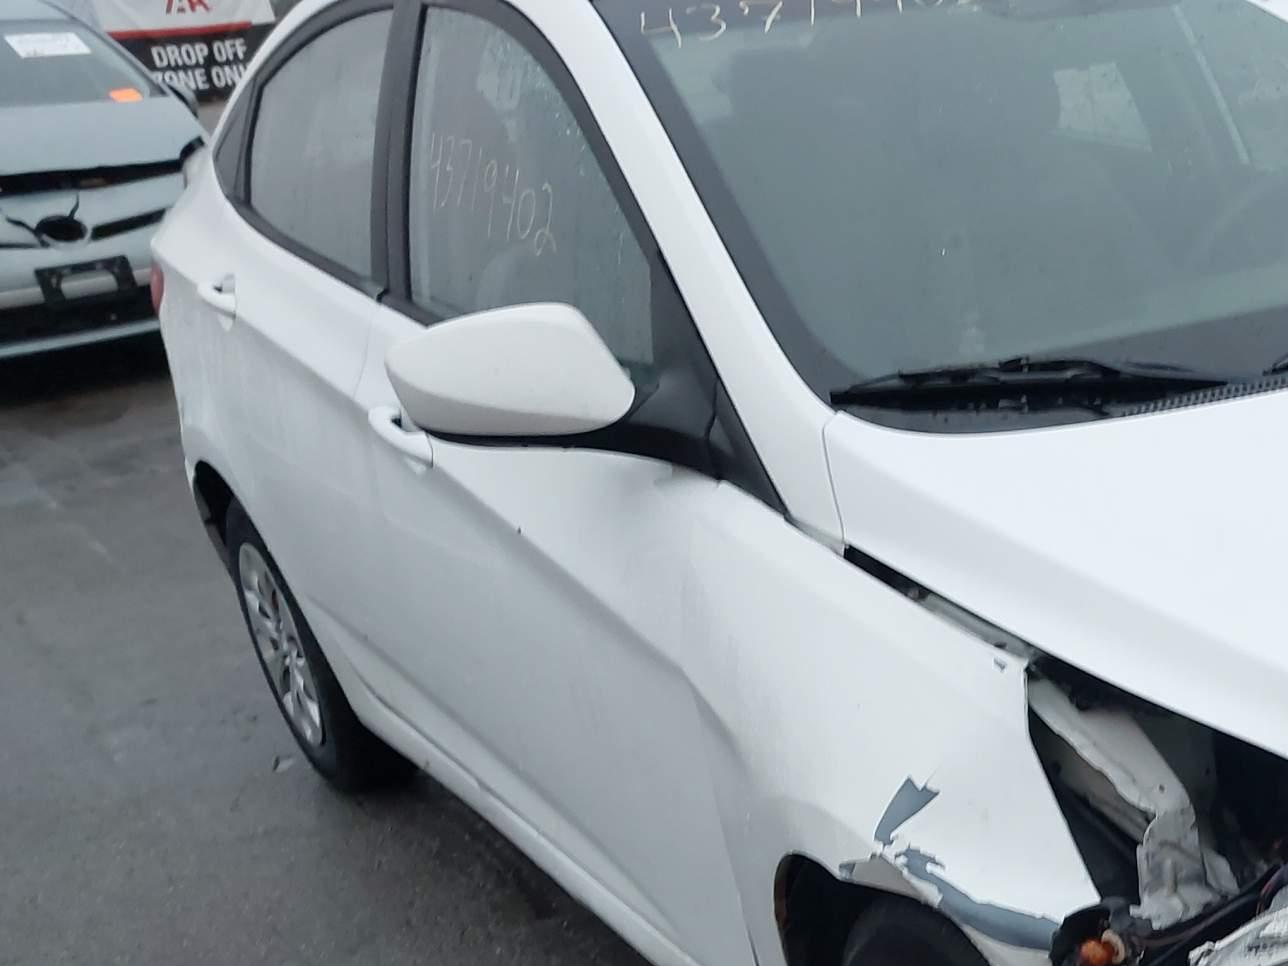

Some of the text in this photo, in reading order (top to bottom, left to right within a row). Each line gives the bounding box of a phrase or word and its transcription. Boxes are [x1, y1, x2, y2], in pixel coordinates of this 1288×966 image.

[151, 38, 247, 68] DROP OFF
[211, 62, 248, 88] ON
